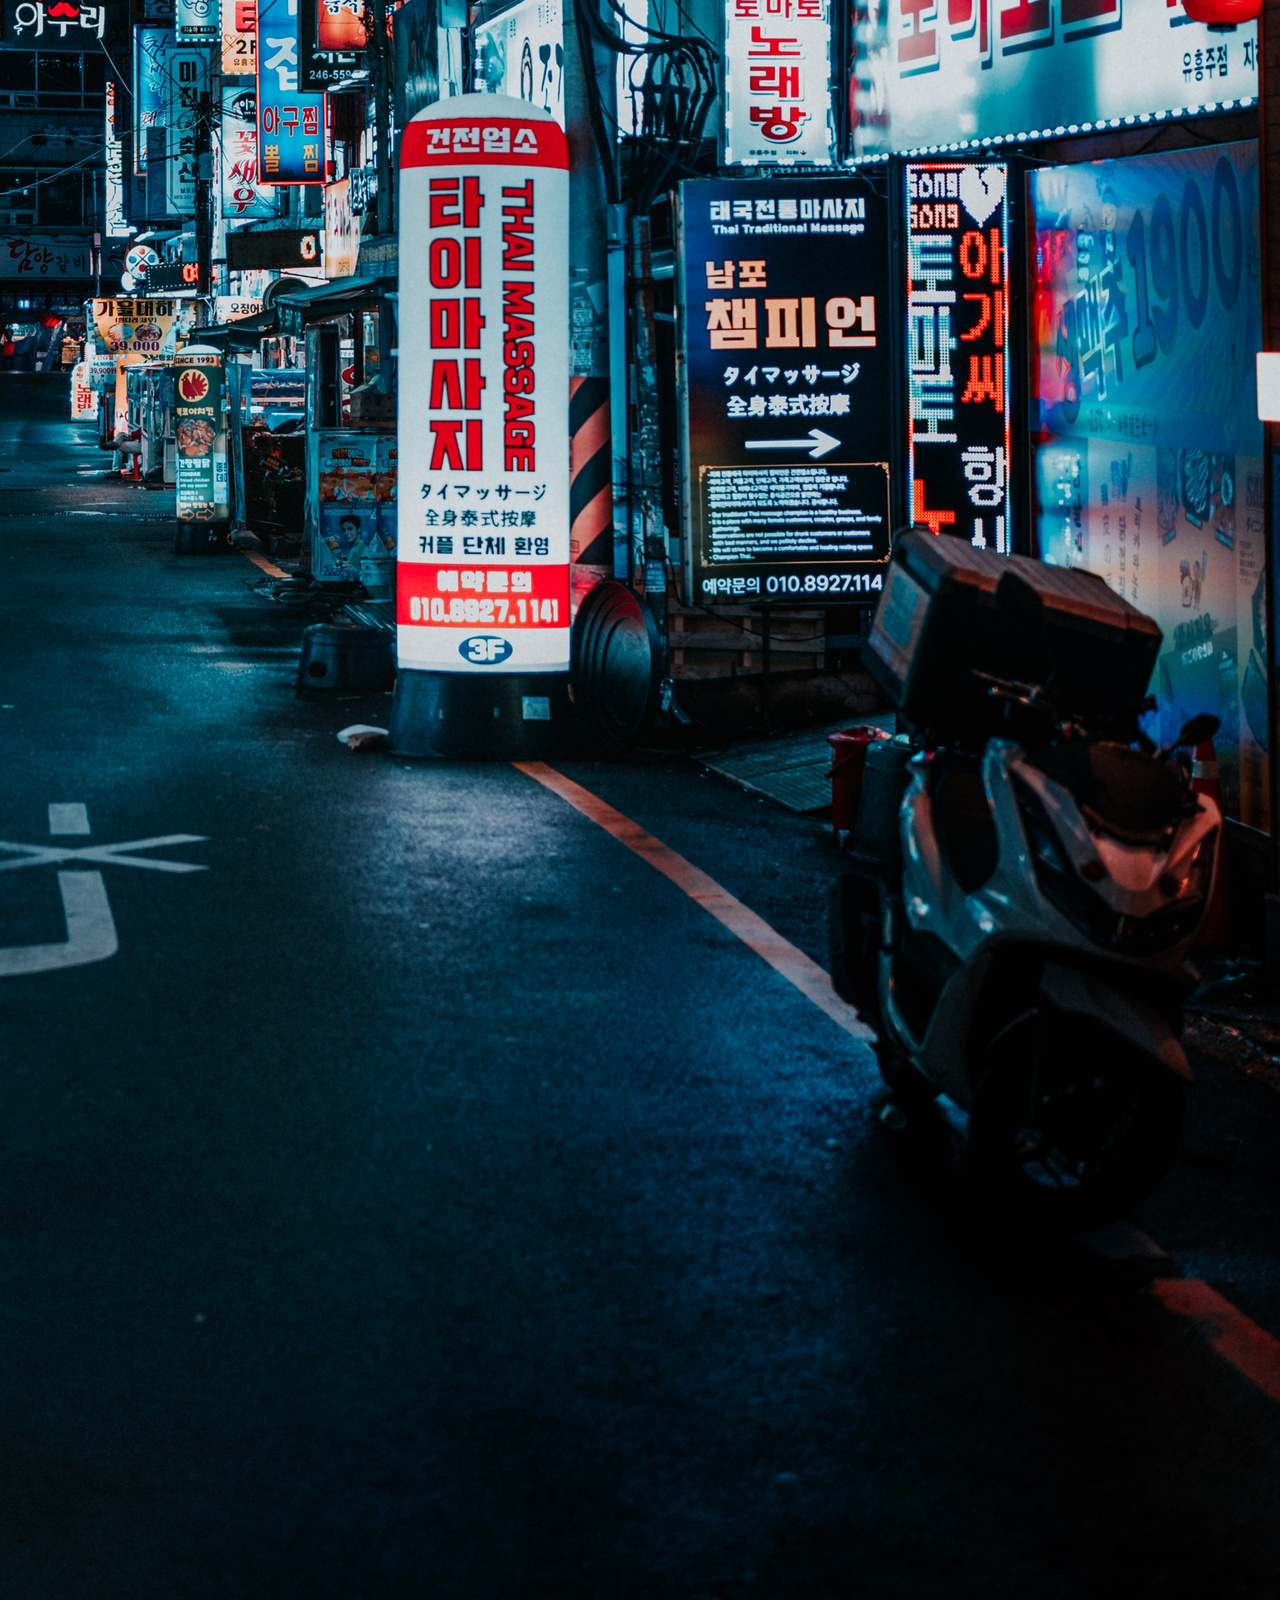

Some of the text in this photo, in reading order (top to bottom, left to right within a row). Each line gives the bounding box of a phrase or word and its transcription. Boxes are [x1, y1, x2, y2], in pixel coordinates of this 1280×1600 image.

[1182, 43, 1229, 82] 유흥주점
[747, 26, 807, 141] 노래방
[263, 105, 319, 137] 아구찜
[426, 126, 539, 155] 건전업소
[227, 130, 257, 214] 꽃새우
[709, 197, 866, 222] 태국전통마사지
[712, 222, 865, 237] Thai Traditional Massage
[705, 259, 768, 291] 남포
[97, 300, 175, 317] 가을대하
[959, 227, 1005, 413] 아가씨
[428, 175, 487, 472] 타이마사지
[501, 178, 536, 473] THAI MASSAGE
[704, 295, 878, 351] 챔피언
[109, 340, 160, 352] 39.000
[174, 356, 215, 365] SINCE 1993
[722, 362, 862, 387] タイマッサージ
[726, 394, 851, 418] 全身泰式按摩
[420, 483, 548, 501] タイマッサージ
[424, 509, 538, 528] 全身泰式按摩
[418, 535, 550, 556] 커플 단체 환영
[436, 570, 533, 594] 예약문의
[701, 576, 761, 596] 예약문의
[409, 596, 559, 623] 010.8927.1141
[467, 638, 506, 661] 3F
